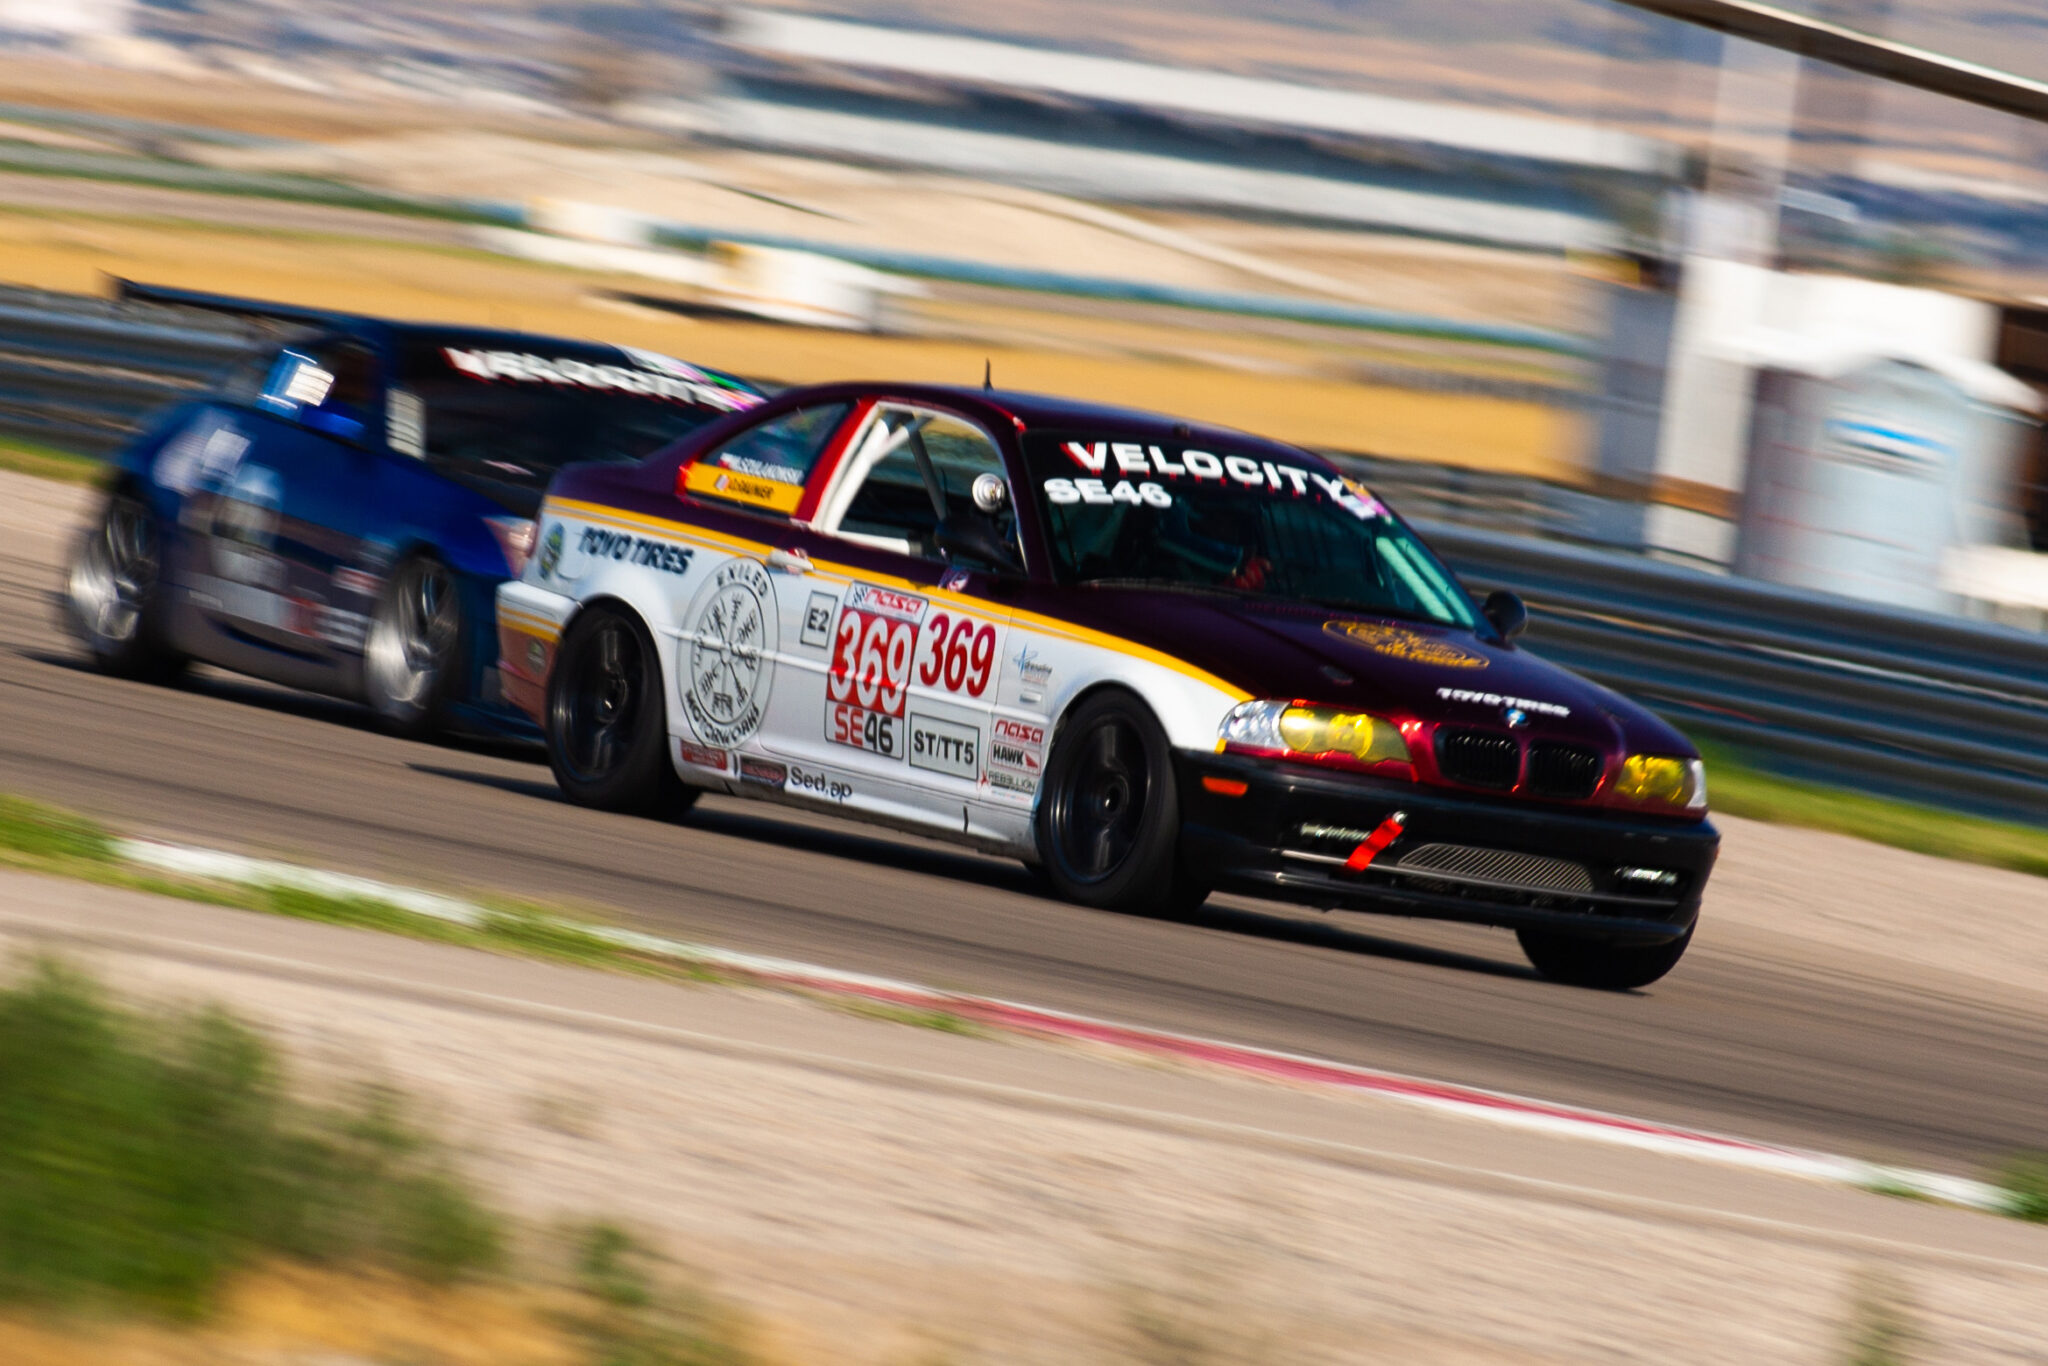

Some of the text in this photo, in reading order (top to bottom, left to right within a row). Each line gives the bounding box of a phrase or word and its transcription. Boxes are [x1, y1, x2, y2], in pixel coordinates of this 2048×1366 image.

[1043, 477, 1173, 508] SE46
[1062, 441, 1344, 502] VELOCITY
[577, 525, 695, 575] TOYO TIRES
[807, 607, 830, 633] E2
[829, 611, 912, 713] 369
[919, 612, 996, 698] 369
[834, 704, 893, 753] SE46
[913, 729, 974, 765] ST/TT5
[993, 743, 1024, 766] HAWK
